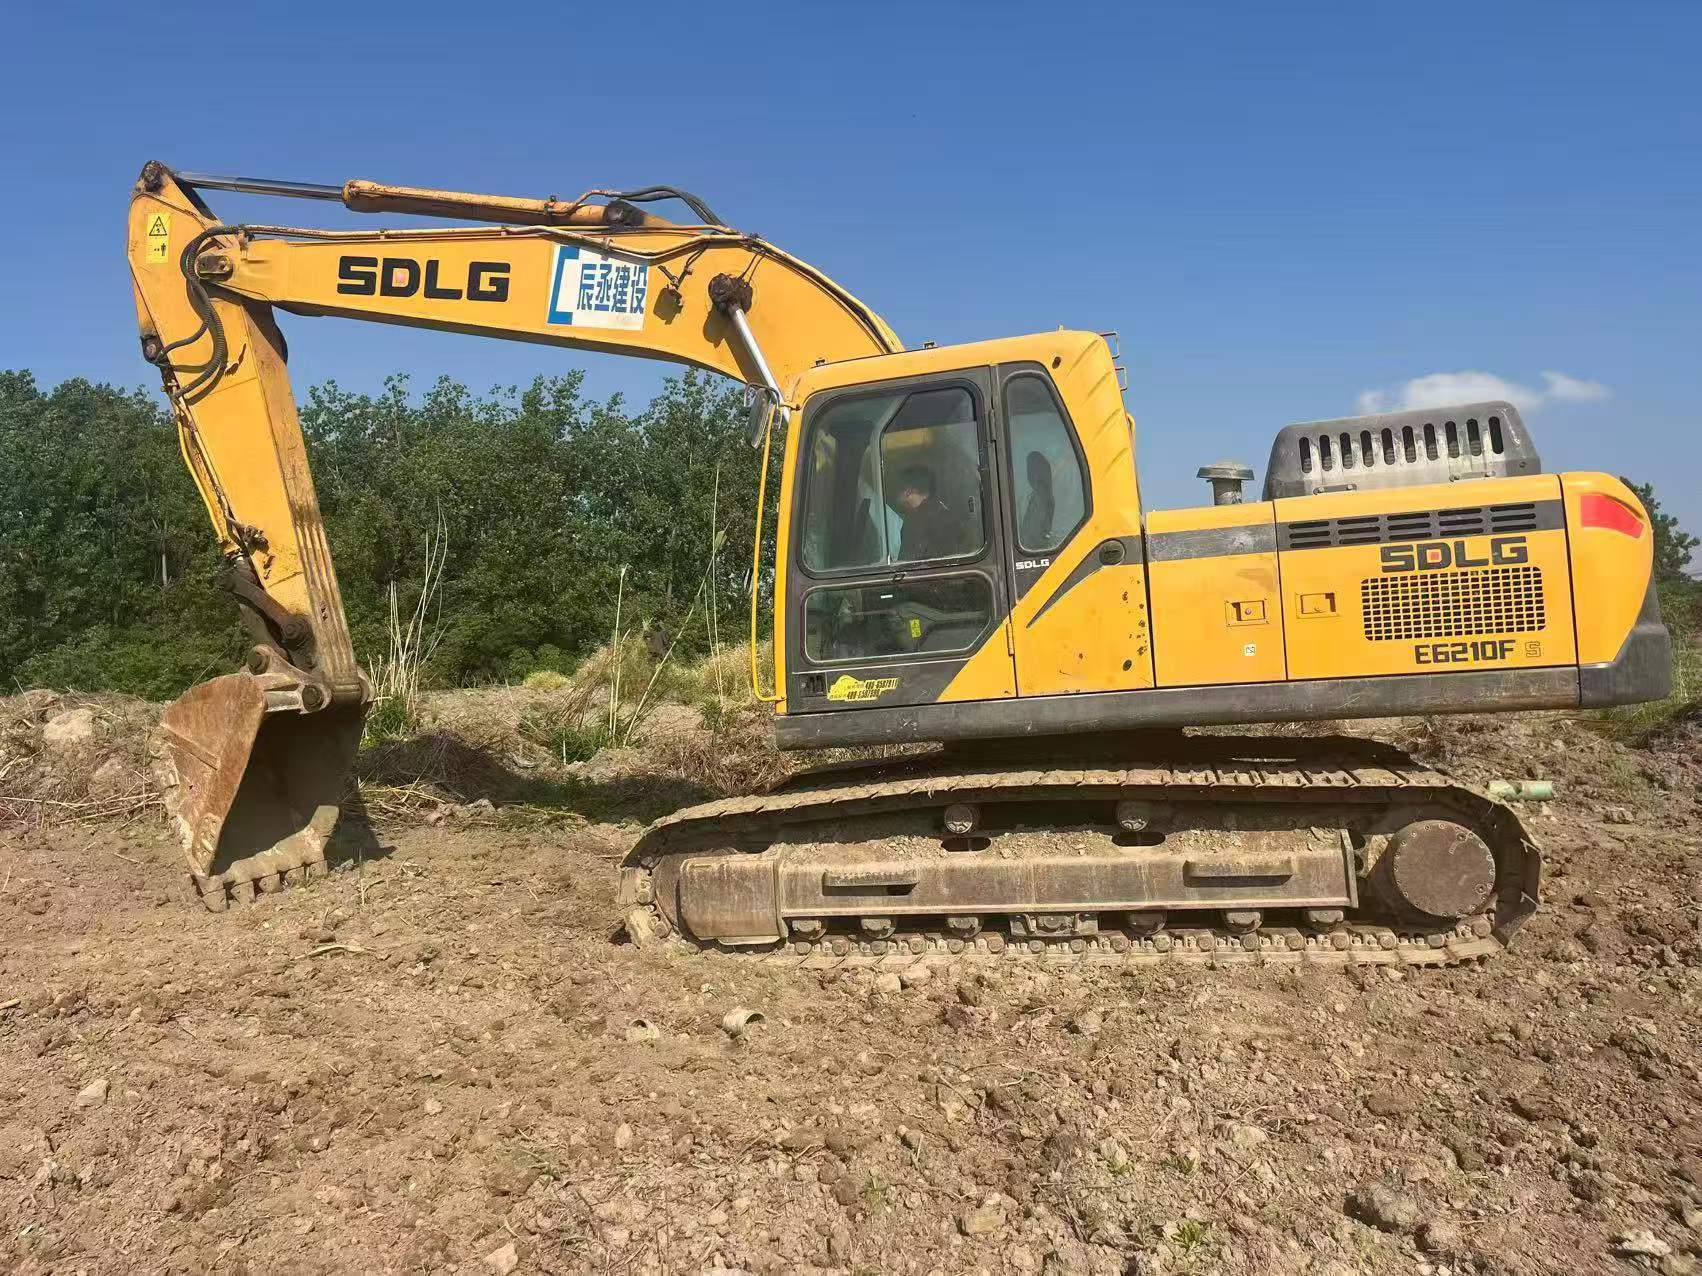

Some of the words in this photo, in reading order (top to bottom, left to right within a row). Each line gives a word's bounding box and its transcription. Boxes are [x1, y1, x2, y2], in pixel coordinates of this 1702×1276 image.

[337, 256, 511, 302] SDLG
[577, 264, 647, 314] 辰丞建设
[1015, 558, 1050, 570] SDLG
[1380, 536, 1528, 573] SDLG
[1414, 640, 1516, 664] E6210F
